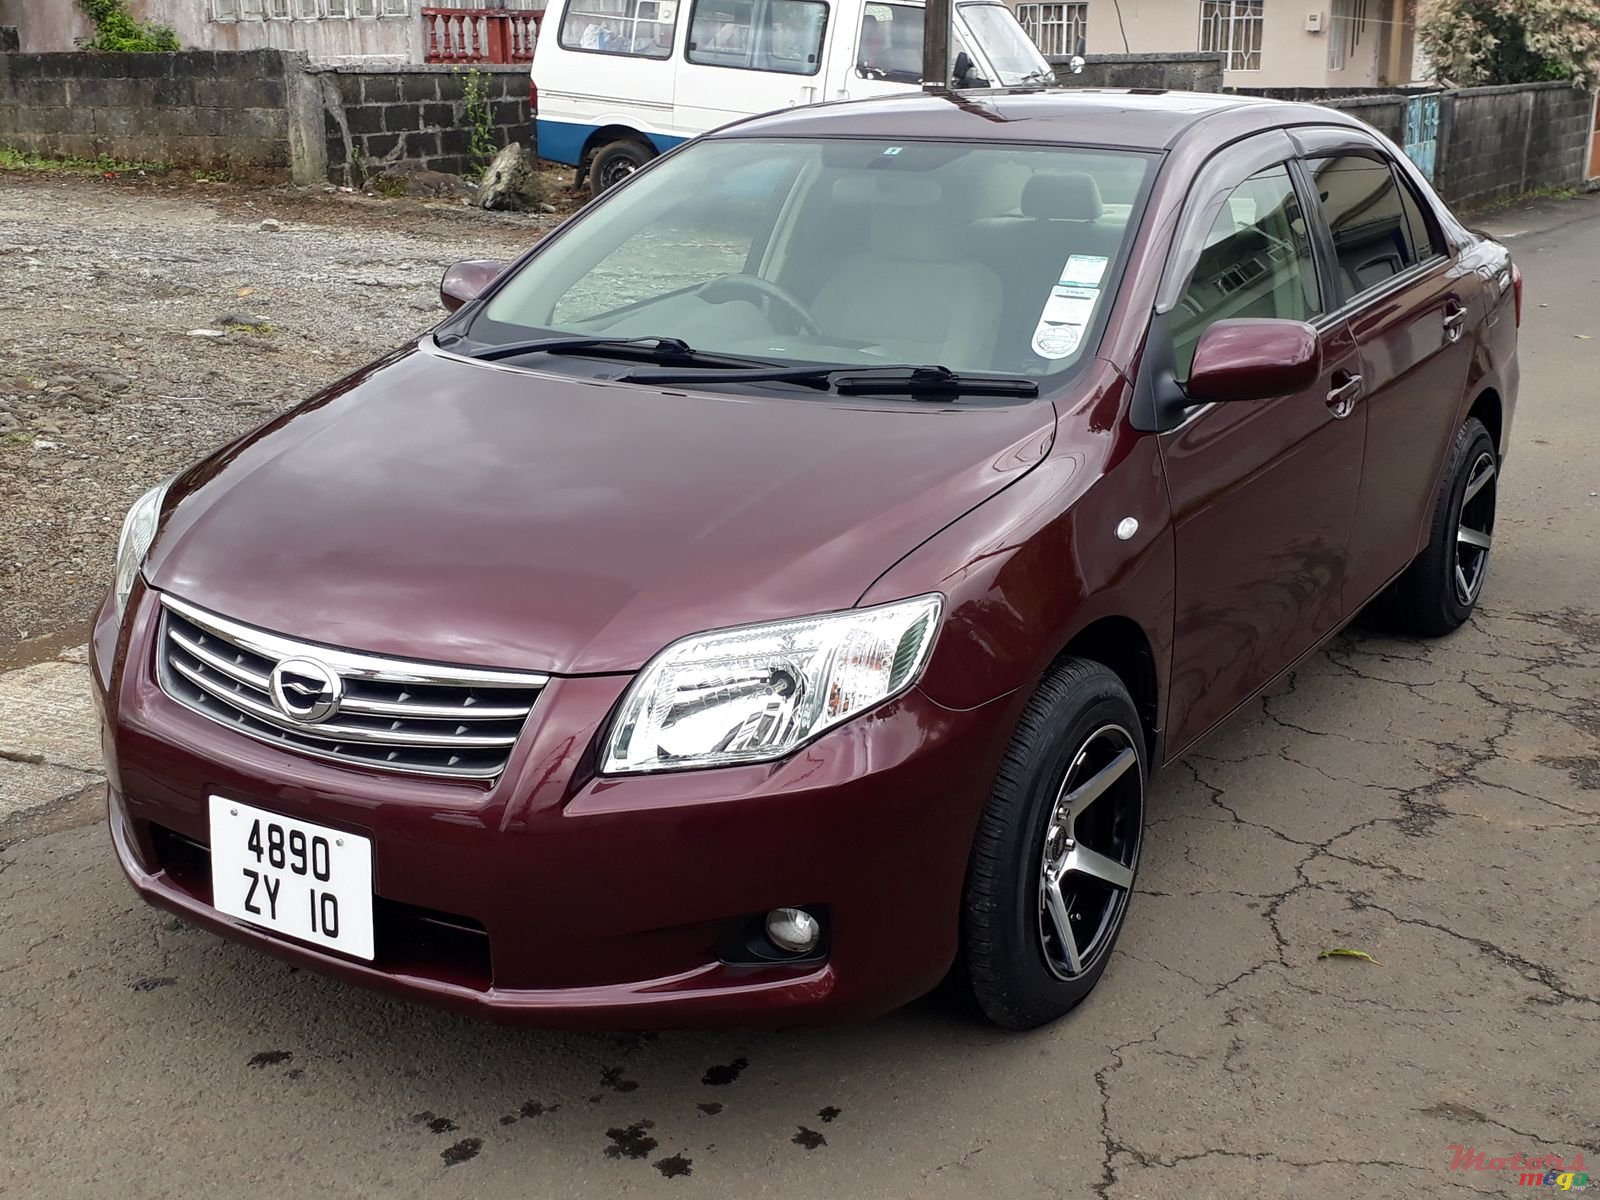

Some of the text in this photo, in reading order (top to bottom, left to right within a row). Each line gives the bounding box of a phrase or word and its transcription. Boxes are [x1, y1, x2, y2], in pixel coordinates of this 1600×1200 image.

[248, 819, 330, 882] 4890
[243, 868, 339, 938] ZY 10
